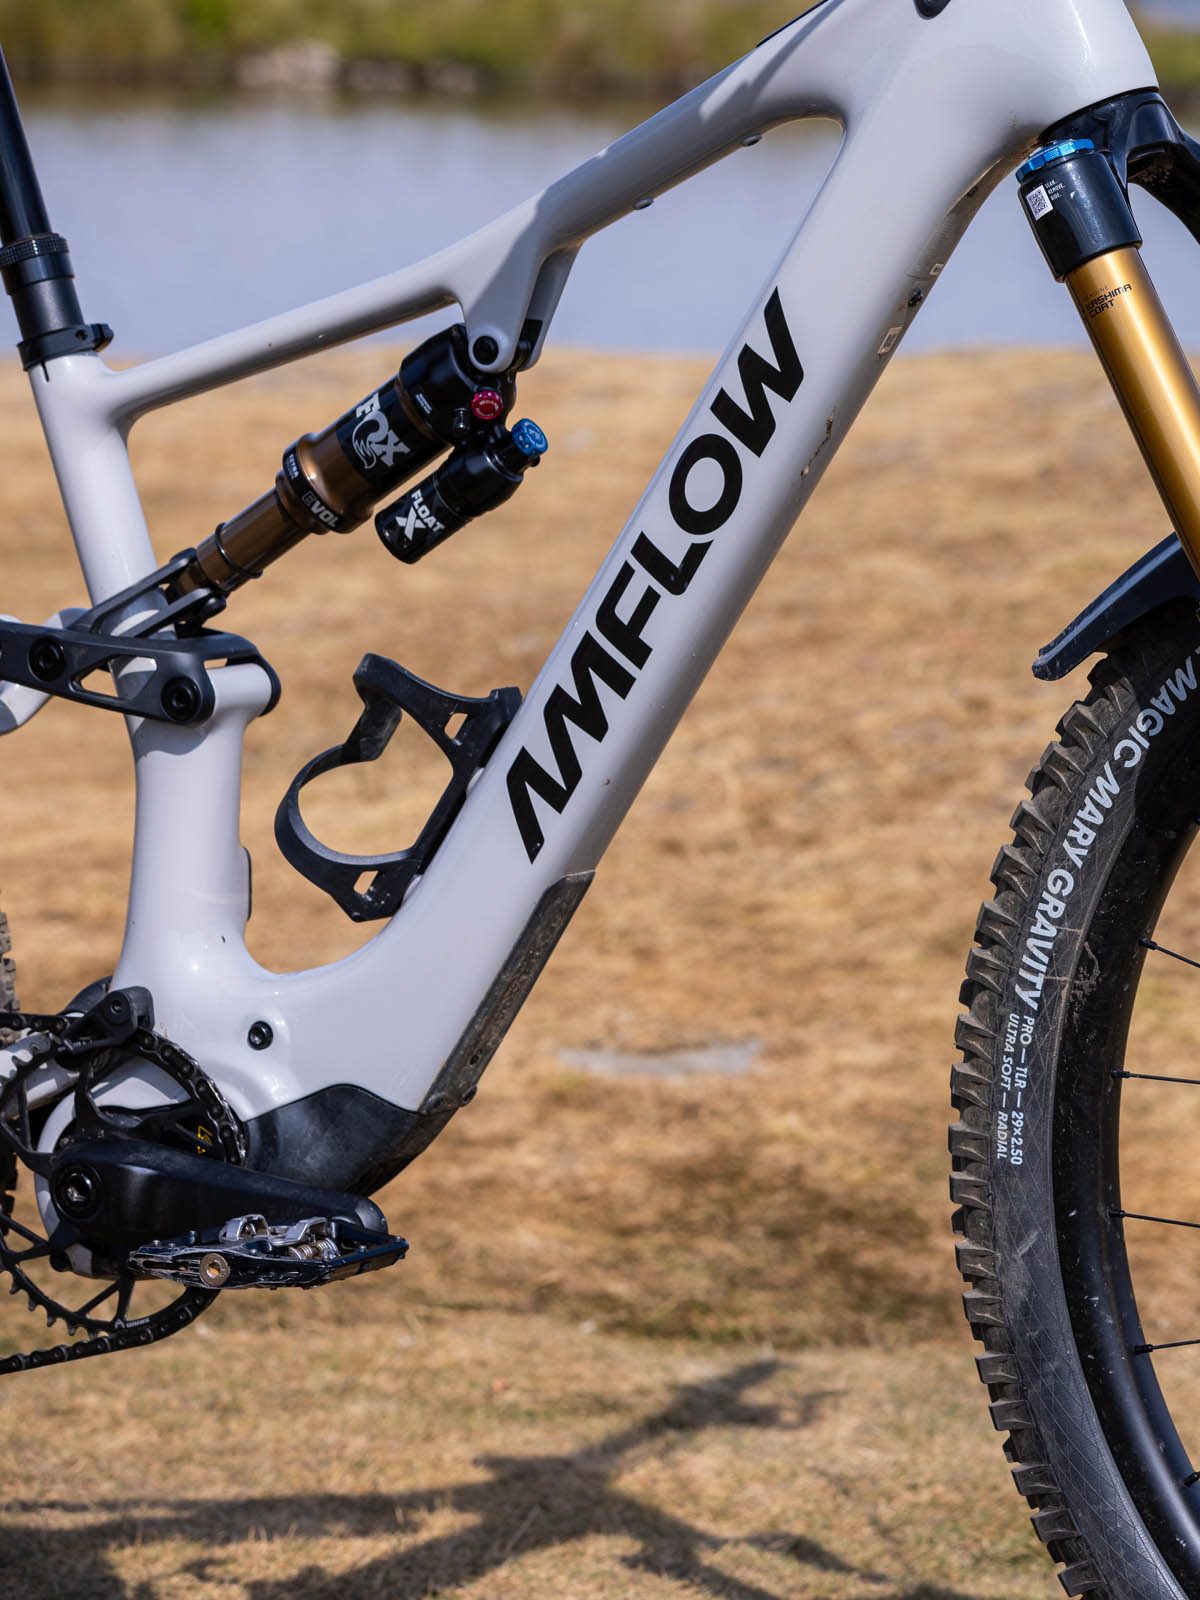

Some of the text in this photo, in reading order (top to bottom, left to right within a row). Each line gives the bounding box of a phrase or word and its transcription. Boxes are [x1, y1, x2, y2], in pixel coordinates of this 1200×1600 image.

[1086, 283, 1133, 310] KASHIMA
[1088, 299, 1114, 318] COAT
[352, 393, 410, 469] FOX
[395, 506, 426, 541] X
[410, 489, 445, 533] FLOAT
[1014, 656, 1199, 1012] MAGIC MARY GRAVITY
[1004, 1013, 1020, 1053] ULTRA
[1020, 1015, 1035, 1046] PRO
[1000, 1055, 1013, 1091] SOFT
[1014, 1066, 1028, 1089] TLR
[996, 1110, 1008, 1159] RADIAL
